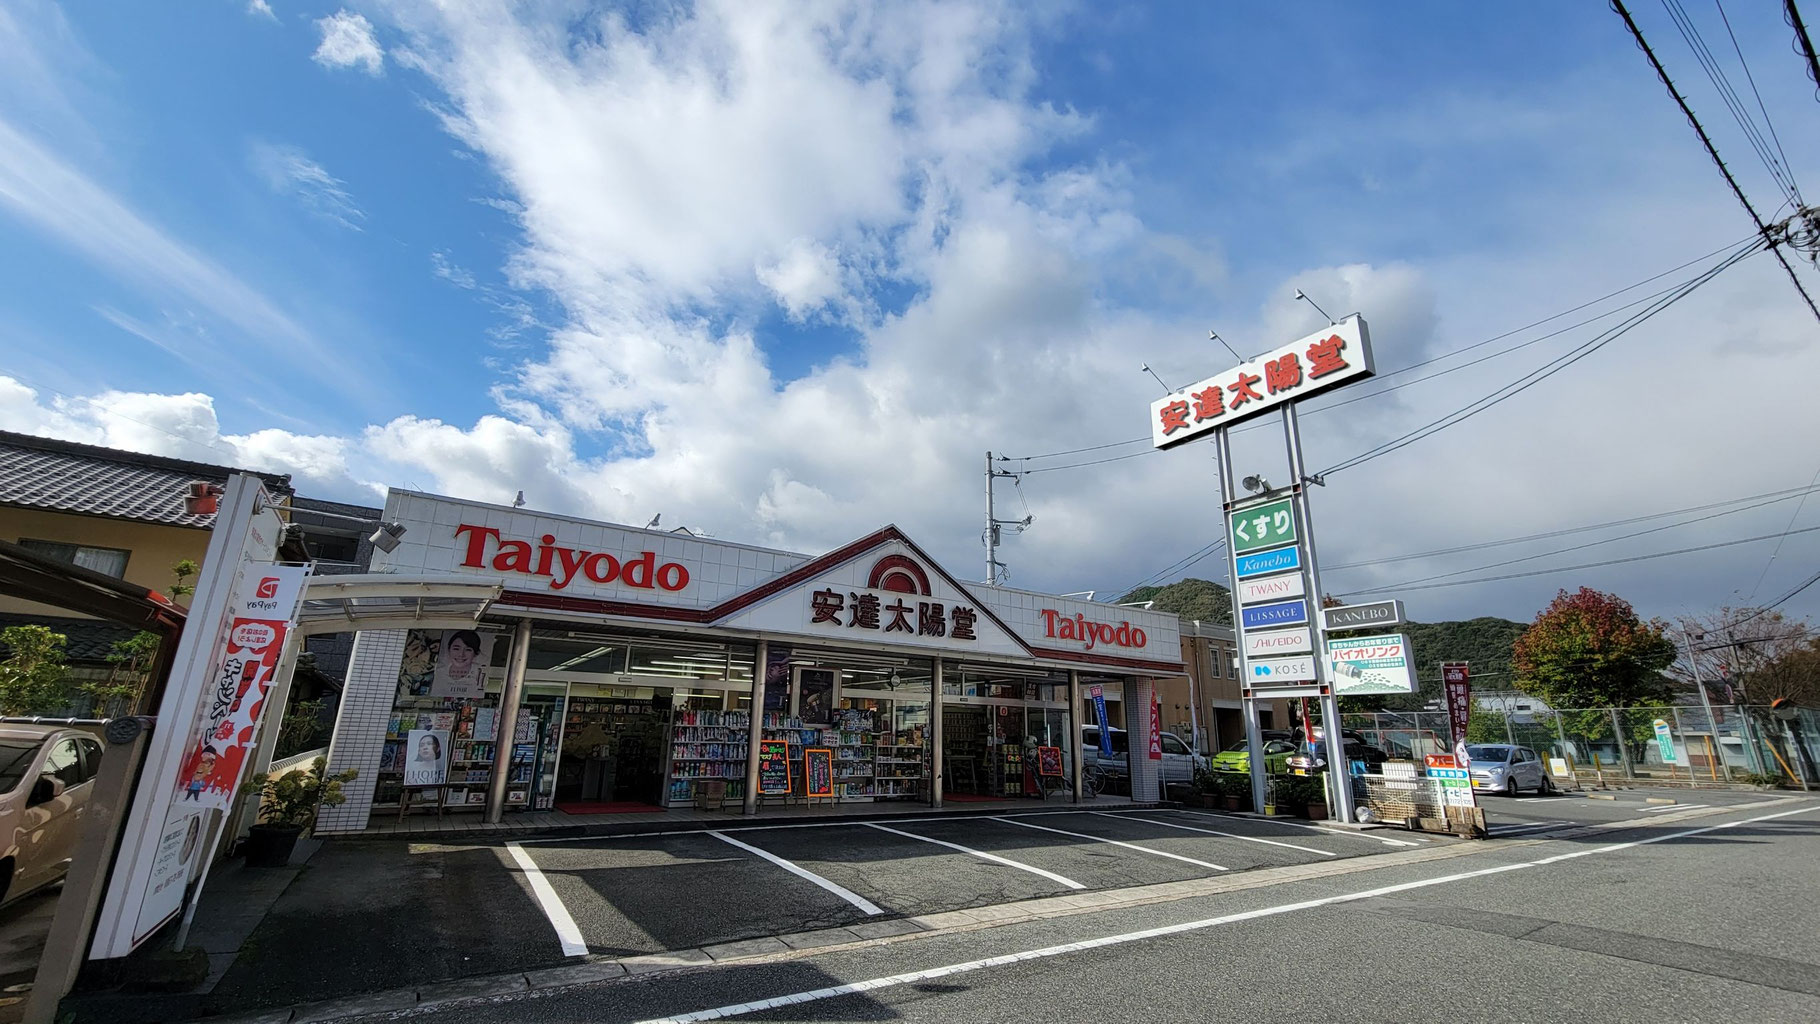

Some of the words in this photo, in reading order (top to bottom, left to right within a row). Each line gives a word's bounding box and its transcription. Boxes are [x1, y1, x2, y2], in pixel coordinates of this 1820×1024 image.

[1160, 333, 1349, 436] 安達太陽堂
[1235, 509, 1290, 542] くすり
[454, 523, 690, 592] Taiyodo
[1243, 555, 1292, 572] Kanebo
[1248, 580, 1291, 597] TWANY
[809, 587, 978, 641] 安達太陽堂
[1250, 607, 1298, 622] LISSAGE
[1332, 607, 1388, 624] KANEBO
[1040, 608, 1147, 650] Taiyodo
[1252, 635, 1302, 649] SHISEIDO
[1334, 645, 1400, 660] バイオリンク
[1274, 661, 1306, 675] KOSÉ
